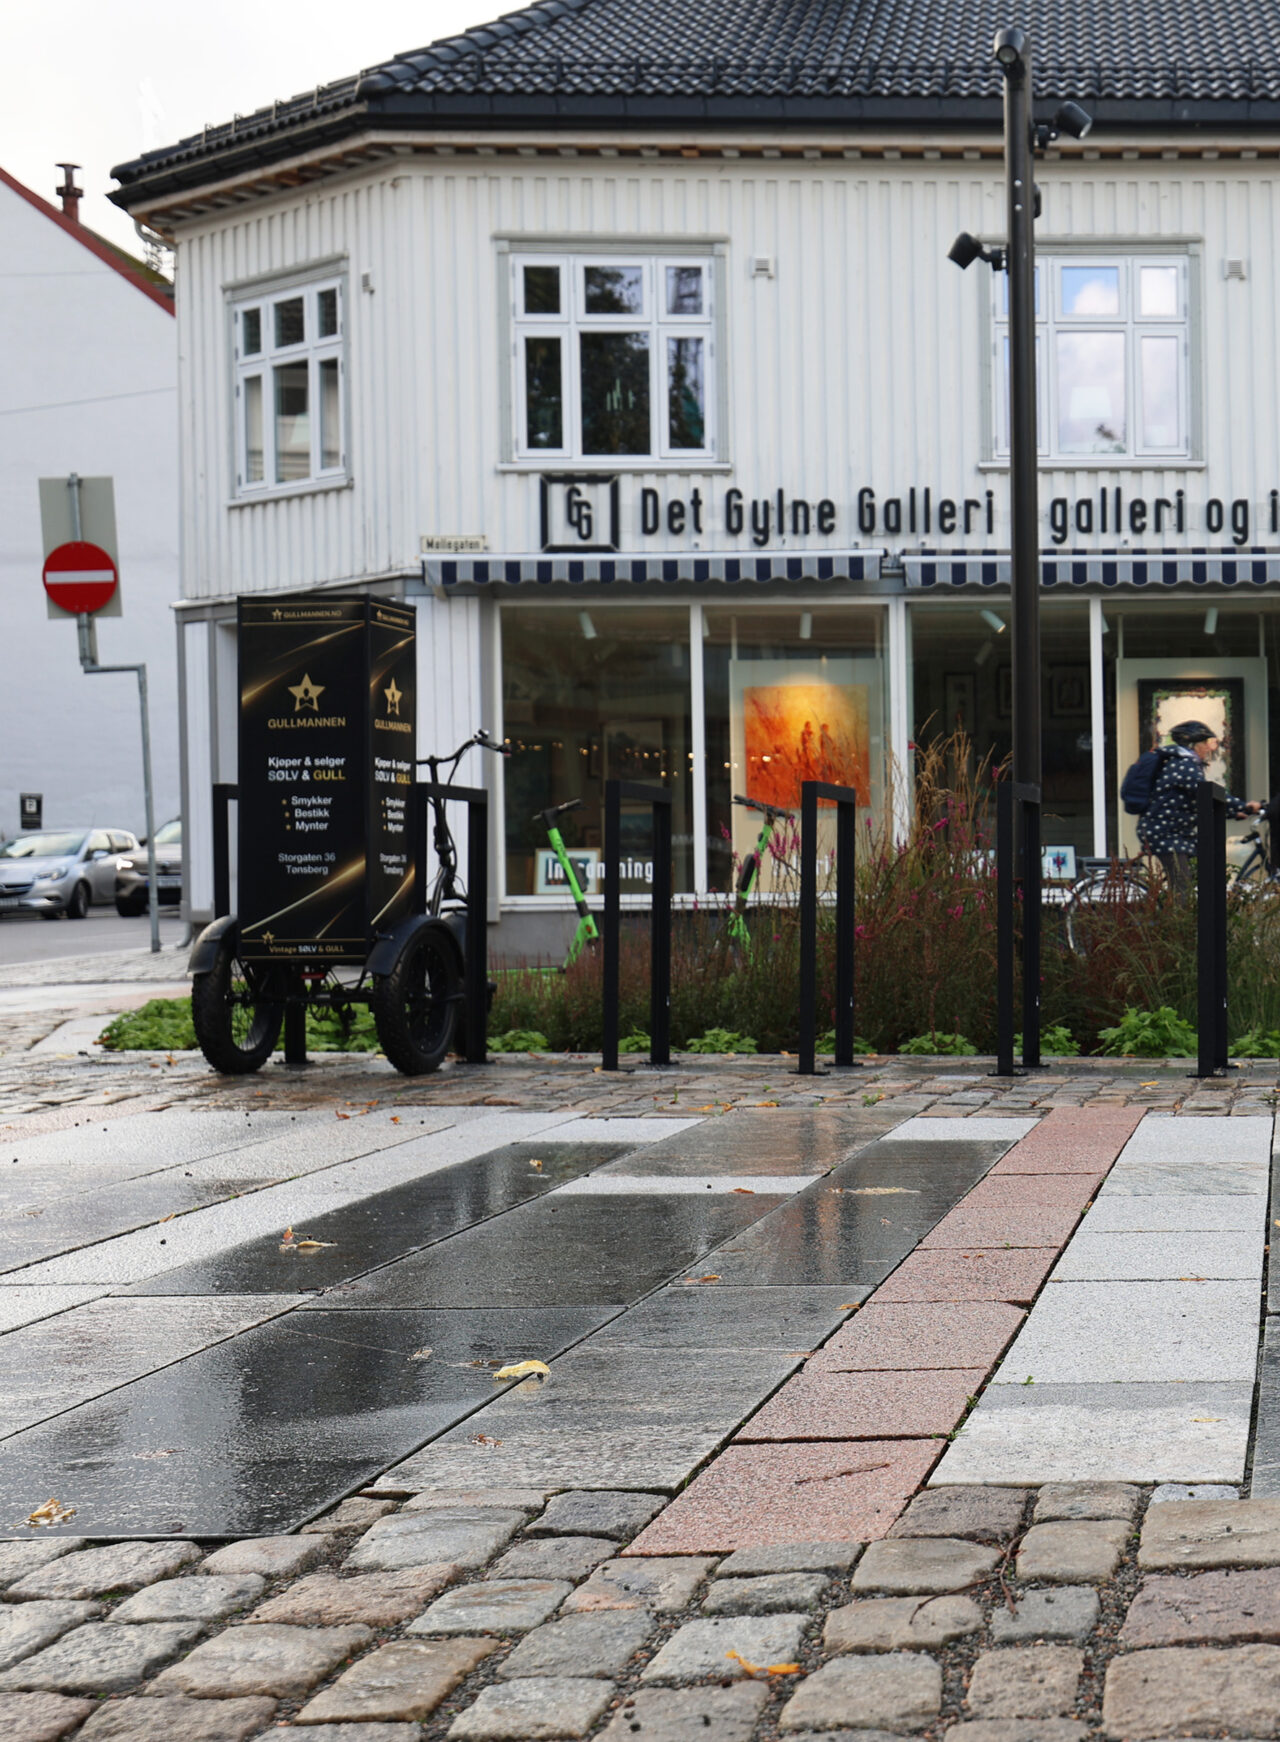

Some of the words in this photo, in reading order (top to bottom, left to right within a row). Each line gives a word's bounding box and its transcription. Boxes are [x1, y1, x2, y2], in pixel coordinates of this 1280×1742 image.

[641, 487, 703, 535] Det
[725, 487, 836, 547] Gylne
[858, 487, 995, 535] Galleri
[1050, 487, 1184, 544] galleri
[1206, 496, 1249, 545] og
[268, 717, 346, 729] GULLMANNEN
[268, 757, 301, 768] Kjøper
[304, 756, 312, 767] &
[314, 756, 346, 767] selger
[268, 770, 299, 781] SØLV
[301, 770, 310, 780] &
[313, 769, 346, 780] GULL
[291, 796, 332, 807] Smykker
[294, 808, 329, 818] Bestikk
[295, 821, 328, 832] Mynter
[279, 853, 322, 863] Storgaten
[286, 865, 328, 875] Tønsberg
[269, 945, 297, 954] Vintage
